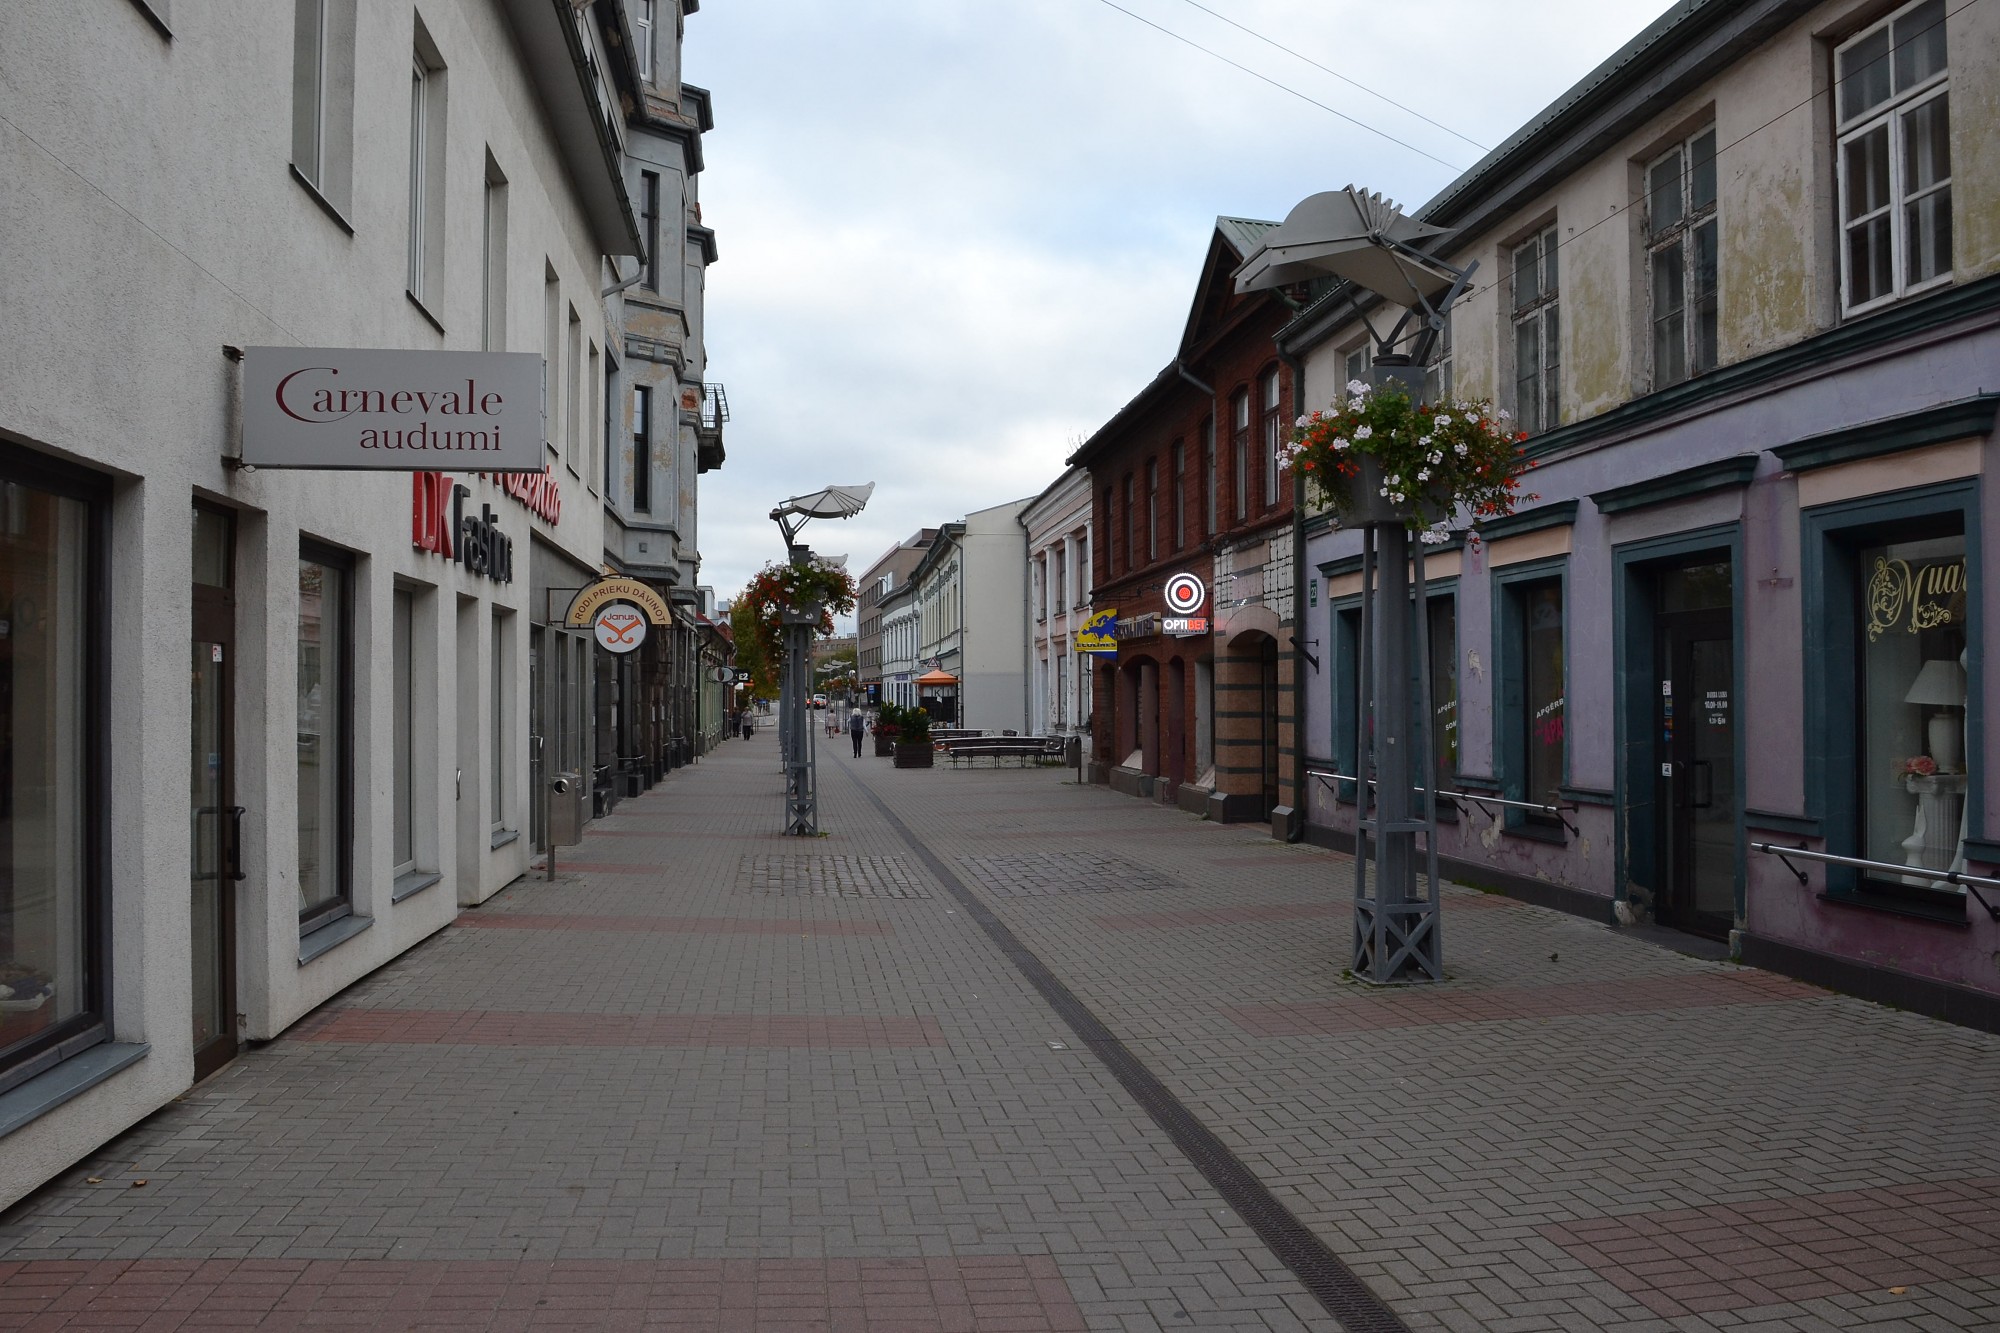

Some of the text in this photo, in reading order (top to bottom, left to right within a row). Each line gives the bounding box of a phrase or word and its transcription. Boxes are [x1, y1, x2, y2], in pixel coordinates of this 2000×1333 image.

[275, 367, 504, 423] Carnevale
[360, 422, 502, 451] audumi
[412, 472, 454, 559] DK
[574, 585, 666, 622] RODI PRIEKU DĀVINOT
[607, 613, 636, 621] Janus
[1164, 619, 1207, 630] OPTIBET
